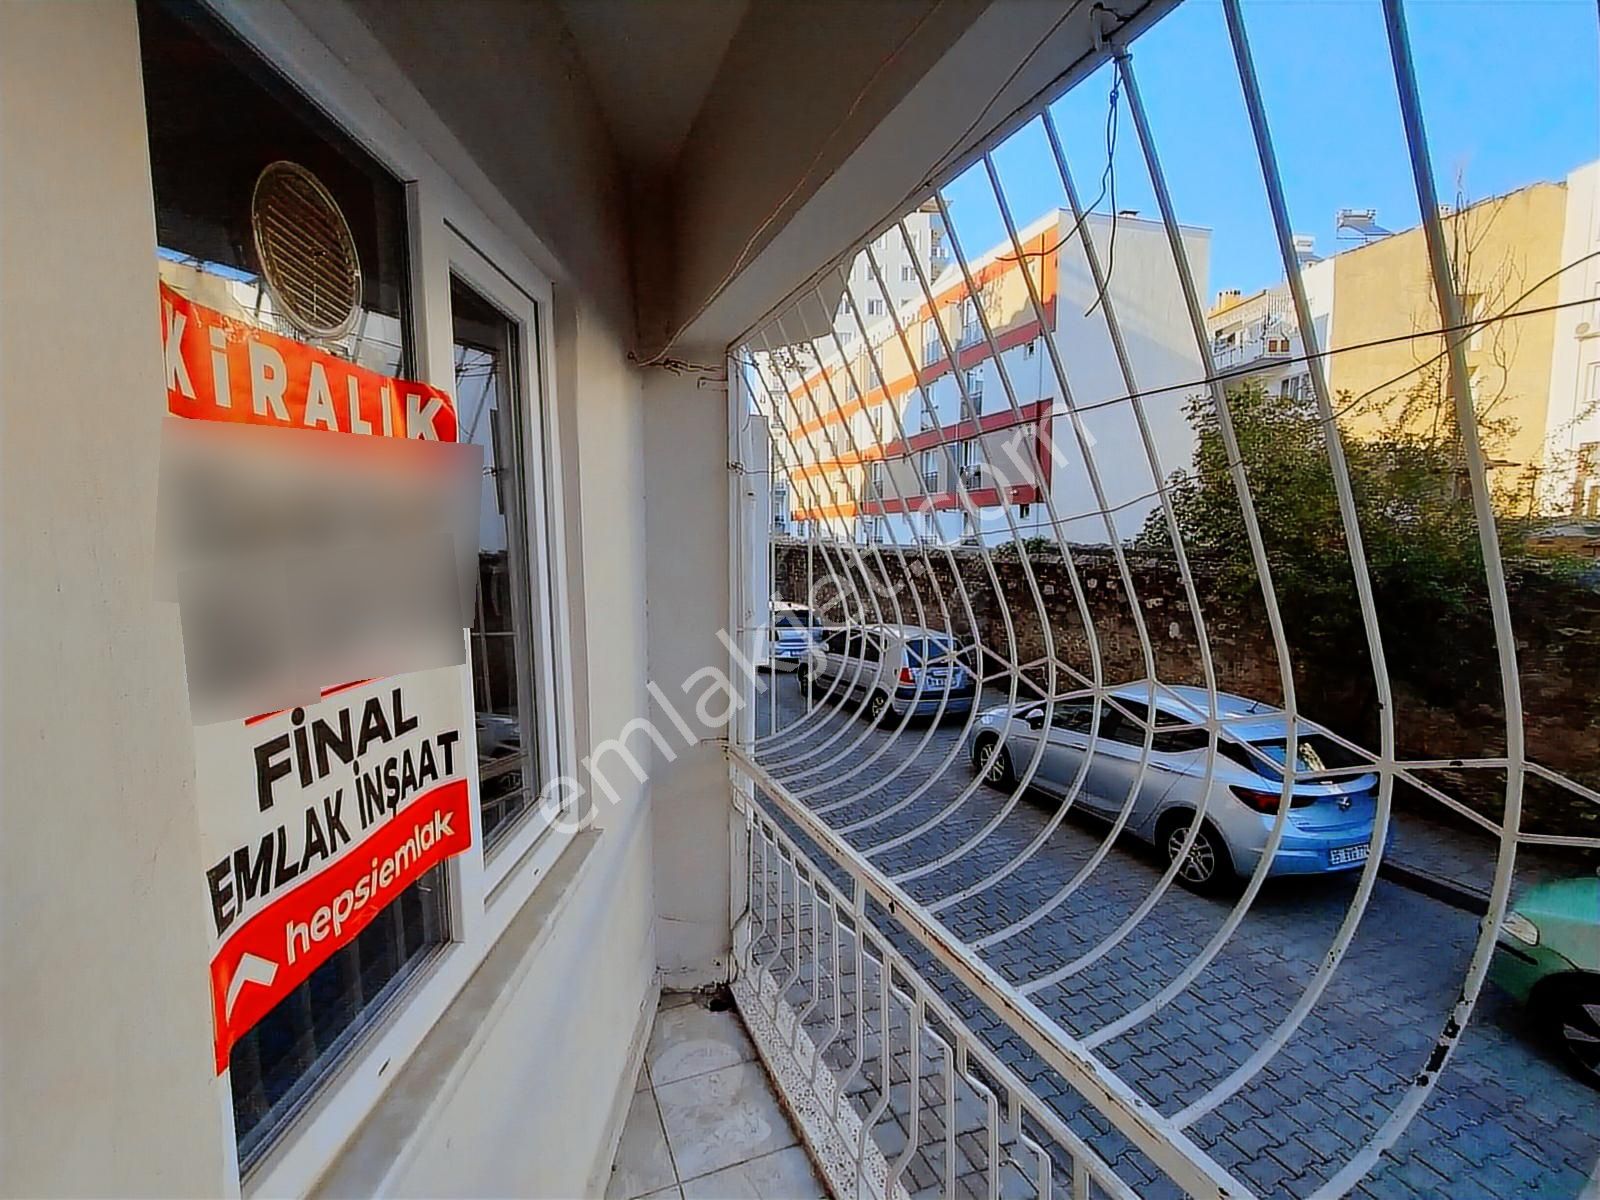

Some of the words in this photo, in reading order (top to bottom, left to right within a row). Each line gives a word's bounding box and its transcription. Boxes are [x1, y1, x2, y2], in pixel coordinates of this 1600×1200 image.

[164, 300, 442, 441] KİRALIK
[254, 688, 418, 812] FİNAL
[206, 789, 351, 938] EMLAK
[352, 730, 459, 830] İNŞAAT
[286, 810, 455, 966] hepsiemlak
